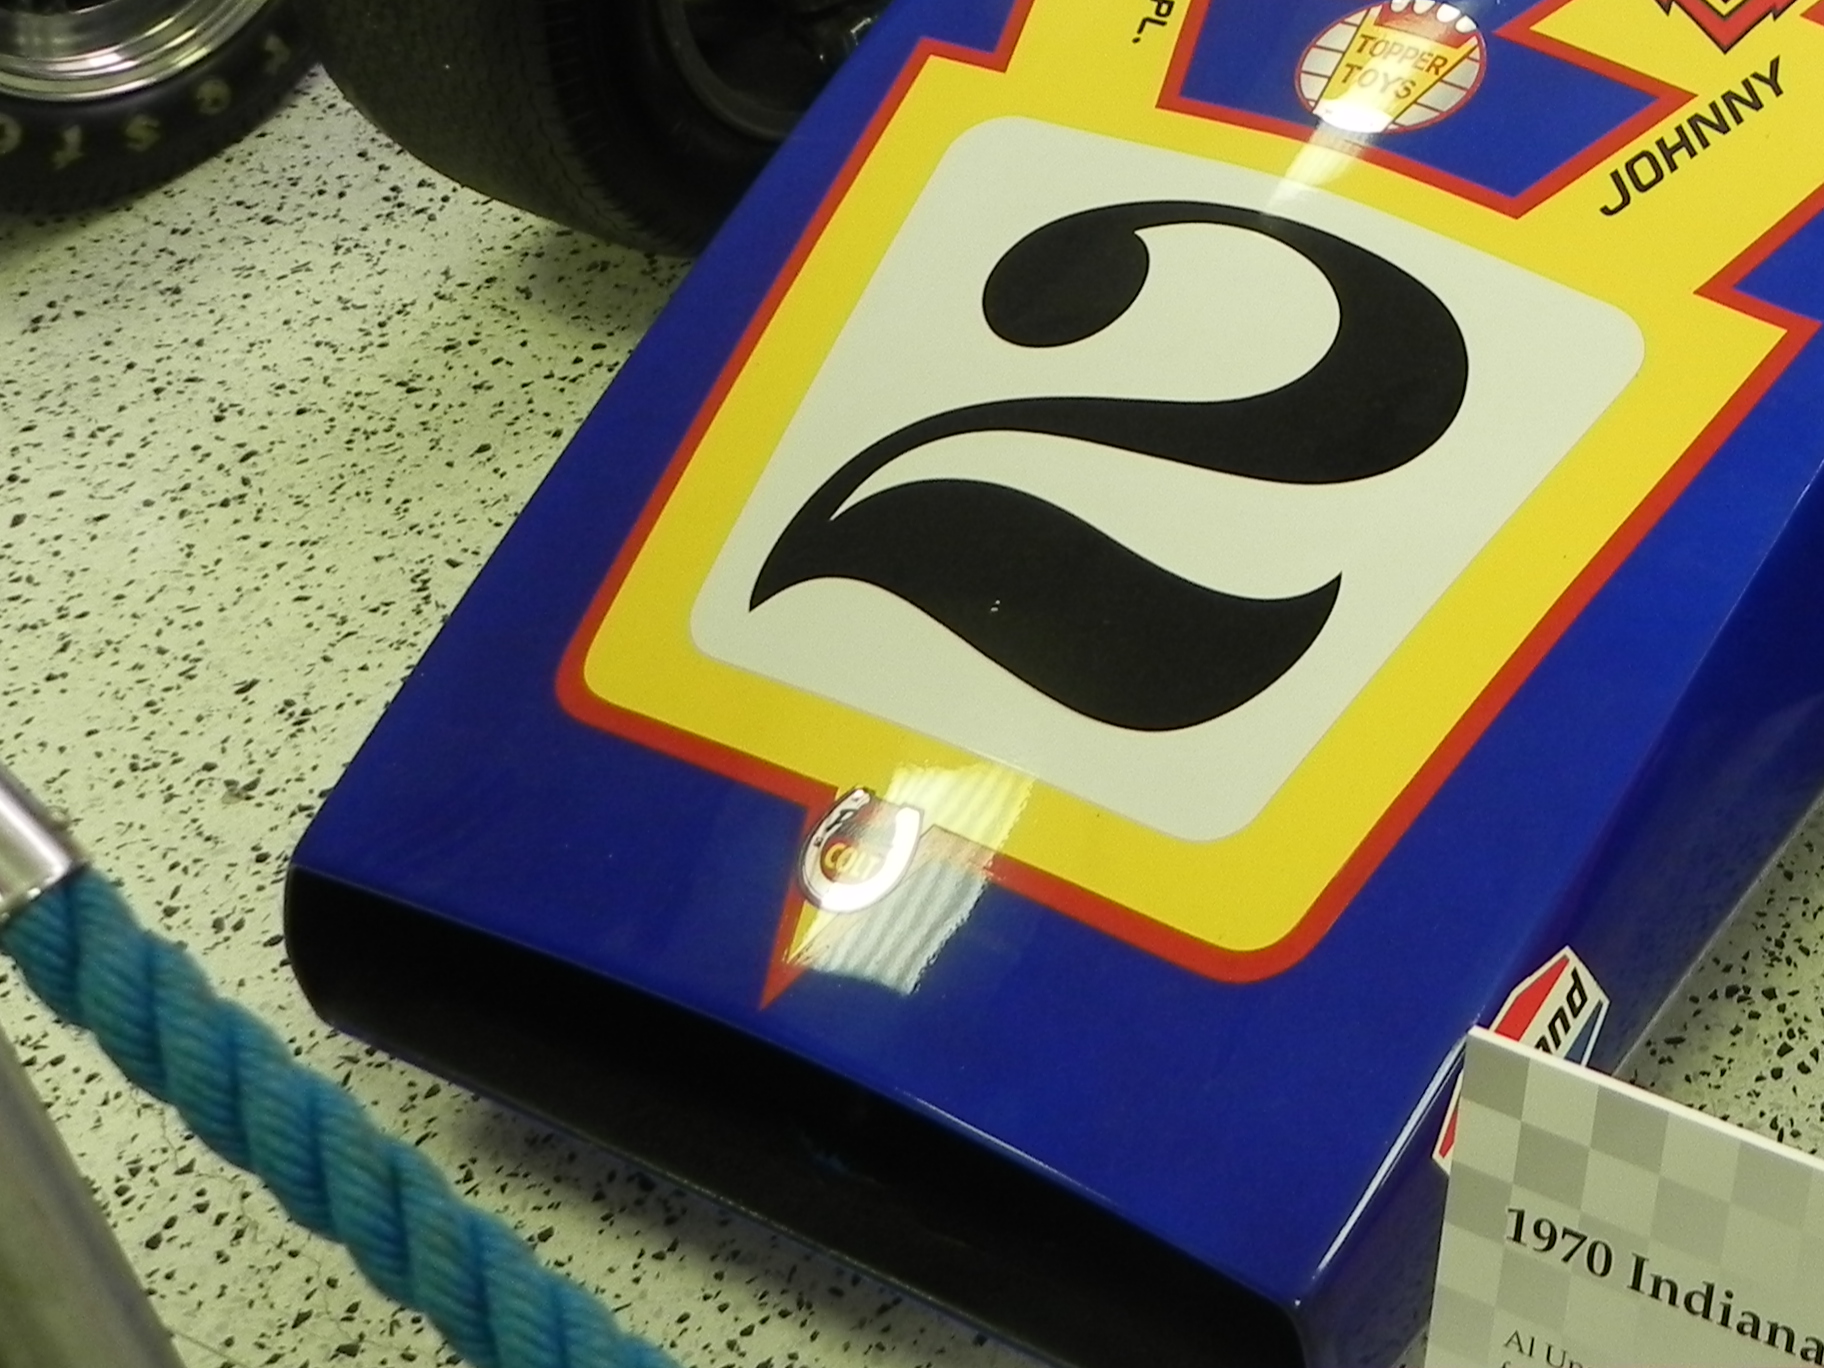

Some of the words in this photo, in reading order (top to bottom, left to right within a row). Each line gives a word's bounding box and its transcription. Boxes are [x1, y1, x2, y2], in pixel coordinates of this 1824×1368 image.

[1340, 62, 1418, 100] TOYS
[1355, 33, 1449, 77] TOPPER
[1599, 55, 1787, 220] JOHNNY
[748, 198, 1470, 734] 2
[1505, 1207, 1614, 1279] 1970
[1503, 1330, 1534, 1358] Al
